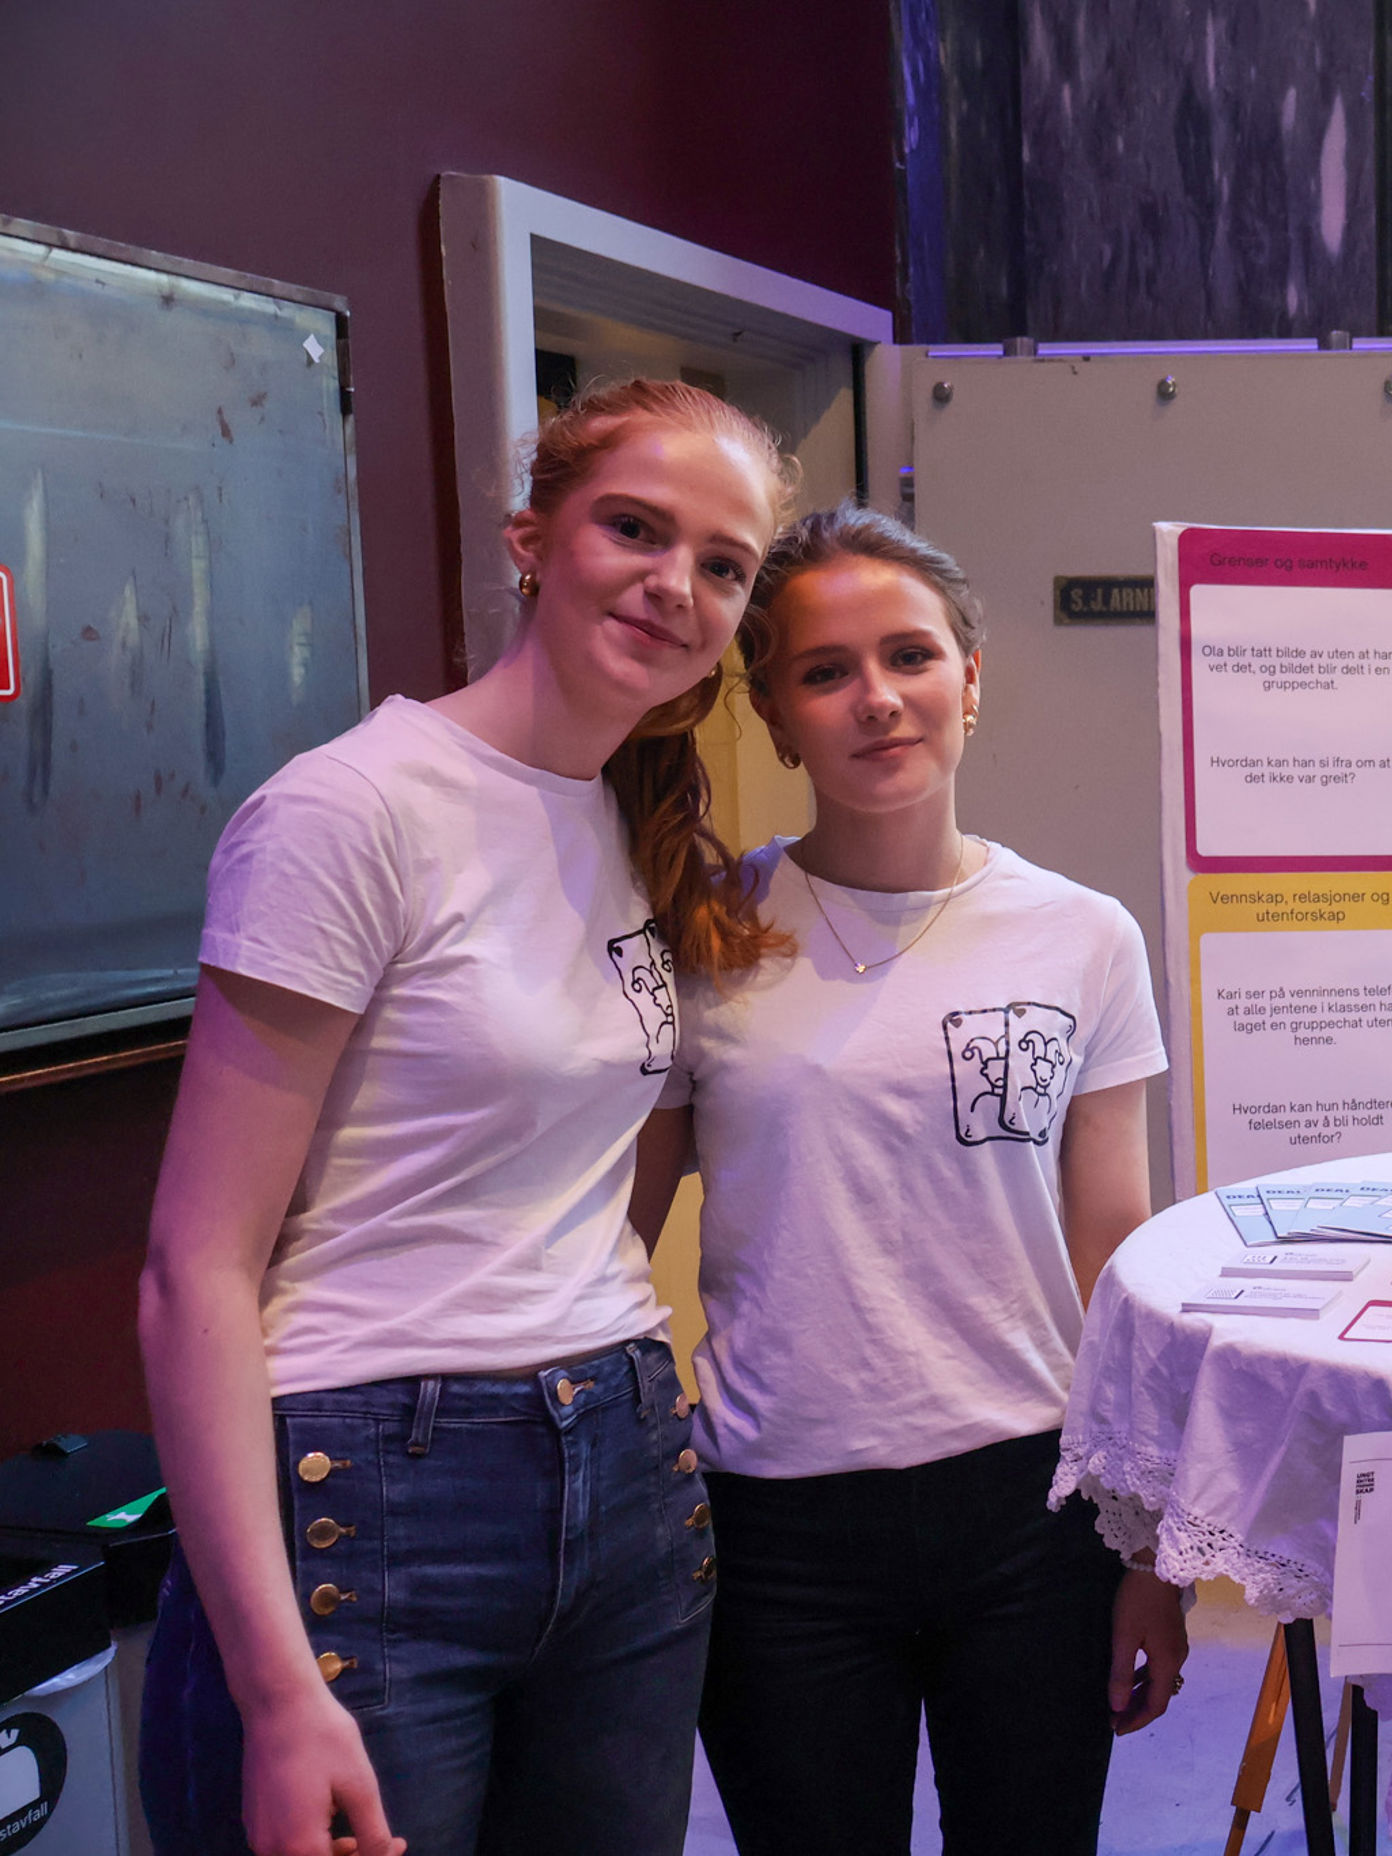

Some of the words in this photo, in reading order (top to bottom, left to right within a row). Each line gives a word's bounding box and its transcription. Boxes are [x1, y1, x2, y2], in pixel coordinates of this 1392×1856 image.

[1209, 553, 1269, 567] Grenser
[1274, 557, 1293, 572] og
[1298, 557, 1368, 572] samtykke
[1201, 645, 1223, 658] Ola
[1227, 645, 1247, 658] blir
[1251, 646, 1272, 659] tatt
[1276, 647, 1306, 659] bilde
[1310, 650, 1324, 659] av
[1327, 648, 1355, 660] uten
[1358, 649, 1370, 660] at
[1208, 662, 1227, 673] vet
[1232, 662, 1256, 675] det,
[1259, 664, 1276, 676] og
[1279, 662, 1314, 675] bildet
[1318, 663, 1337, 675] blir
[1341, 663, 1364, 675] delt
[1374, 667, 1390, 675] en
[1263, 678, 1338, 692] gruppechat.
[1210, 756, 1263, 768] Hvordan
[1267, 756, 1289, 768] kan
[1293, 756, 1315, 768] han
[1319, 757, 1330, 768] si
[1332, 756, 1353, 768] ifra
[1355, 759, 1375, 768] om
[1378, 757, 1391, 768] at
[1244, 772, 1265, 784] det
[1269, 772, 1294, 784] ikke
[1298, 774, 1316, 784] var
[1320, 772, 1356, 787] greit?
[1209, 891, 1288, 906] Vennskap,
[1292, 890, 1366, 905] relasjoner
[1371, 892, 1390, 905] og
[1256, 908, 1346, 923] utenforskap
[1217, 988, 1241, 1001] Kari
[1245, 989, 1265, 1000] ser
[1269, 987, 1285, 1001] på
[1289, 987, 1360, 999] venninnens
[1226, 1004, 1240, 1016] at
[1243, 1004, 1266, 1016] alle
[1269, 1003, 1318, 1017] jentene
[1327, 1001, 1377, 1013] klassen
[1233, 1019, 1266, 1034] laget
[1270, 1021, 1286, 1031] en
[1289, 1017, 1363, 1033] gruppechat
[1294, 1034, 1336, 1046] henne.
[1232, 1102, 1286, 1115] Hvordan
[1289, 1101, 1312, 1113] kan
[1316, 1100, 1339, 1112] hun
[1248, 1118, 1301, 1131] følelsen
[1304, 1119, 1319, 1129] av
[1323, 1115, 1330, 1128] å
[1334, 1115, 1349, 1127] bli
[1352, 1114, 1384, 1126] holdt
[1289, 1131, 1342, 1146] utenfor?
